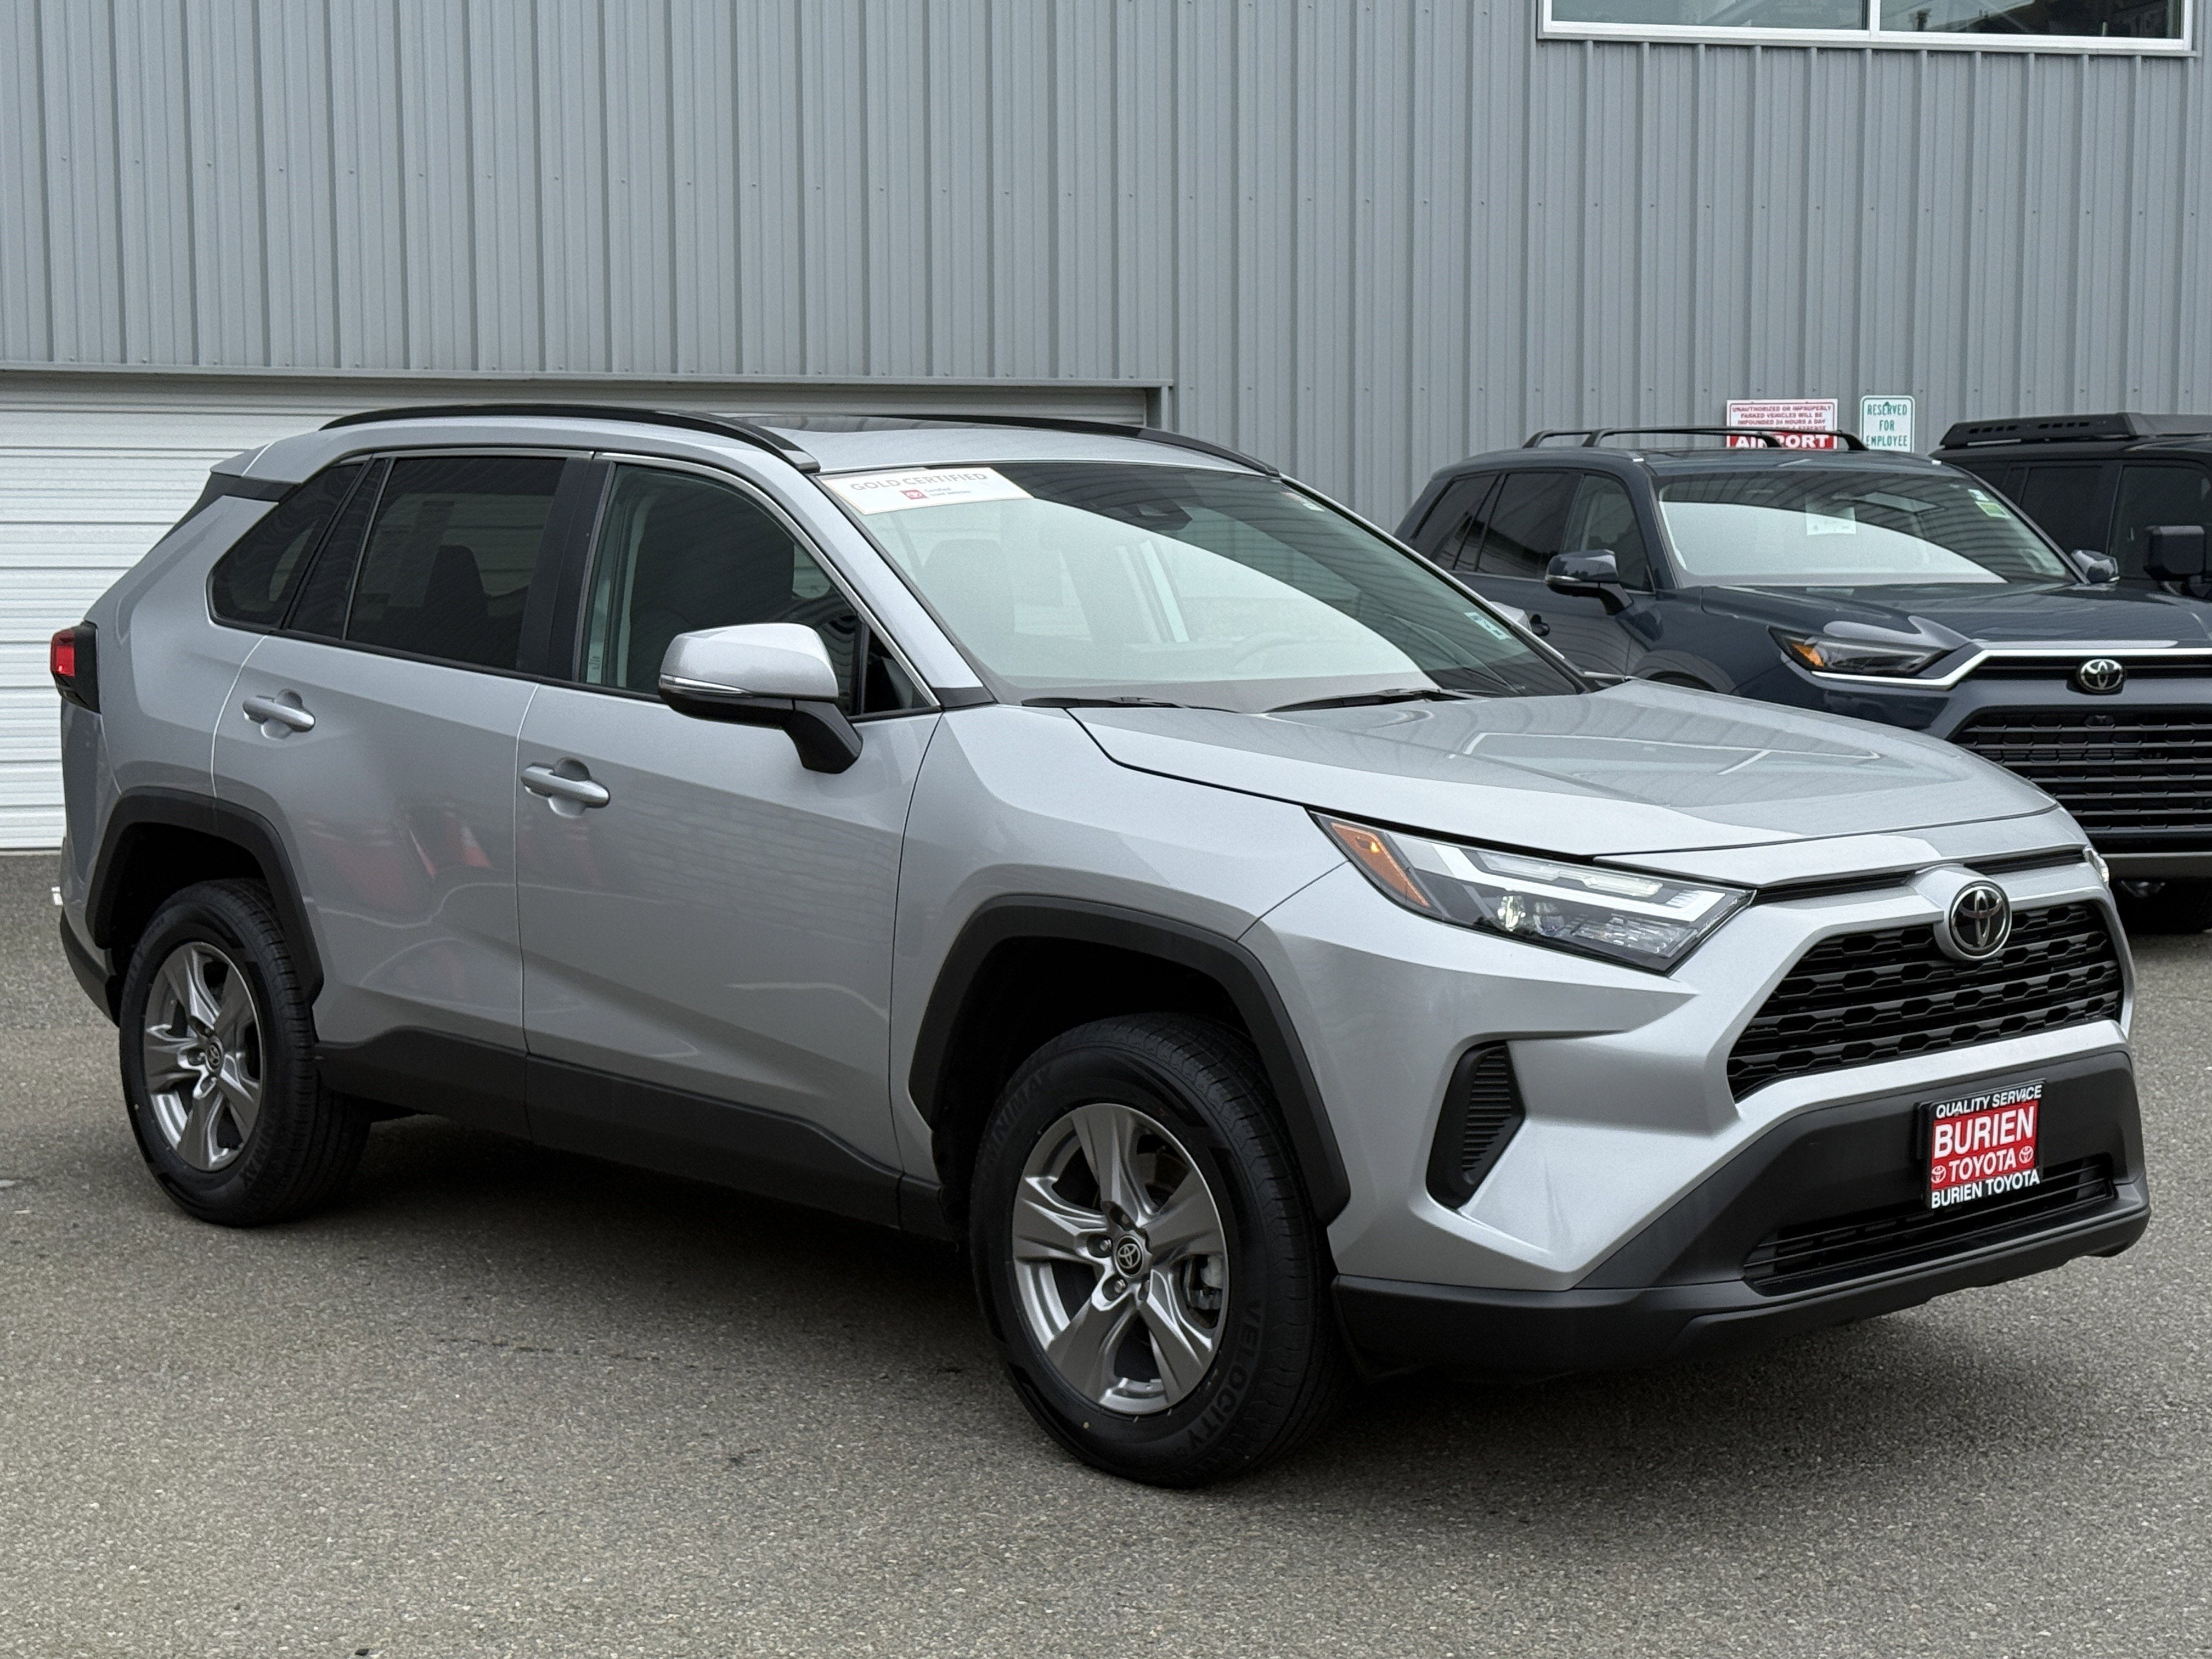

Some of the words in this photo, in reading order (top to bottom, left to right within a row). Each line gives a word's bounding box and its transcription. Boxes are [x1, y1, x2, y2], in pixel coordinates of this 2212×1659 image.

[1867, 403, 1908, 415] RESERVED
[1879, 419, 1895, 431] FOR
[1866, 435, 1908, 447] EMPLOYEE
[850, 478, 901, 491] GOLD
[902, 472, 988, 486] CERTIFIED
[1936, 1095, 1990, 1119] QUALITY
[1992, 1084, 2043, 1108] SERVICE
[1934, 1105, 2035, 1159] BURIEN
[1948, 1147, 2017, 1183] TOYOTA
[1931, 1182, 1983, 1209] BURIEN
[1985, 1169, 2040, 1195] TOYOTA
